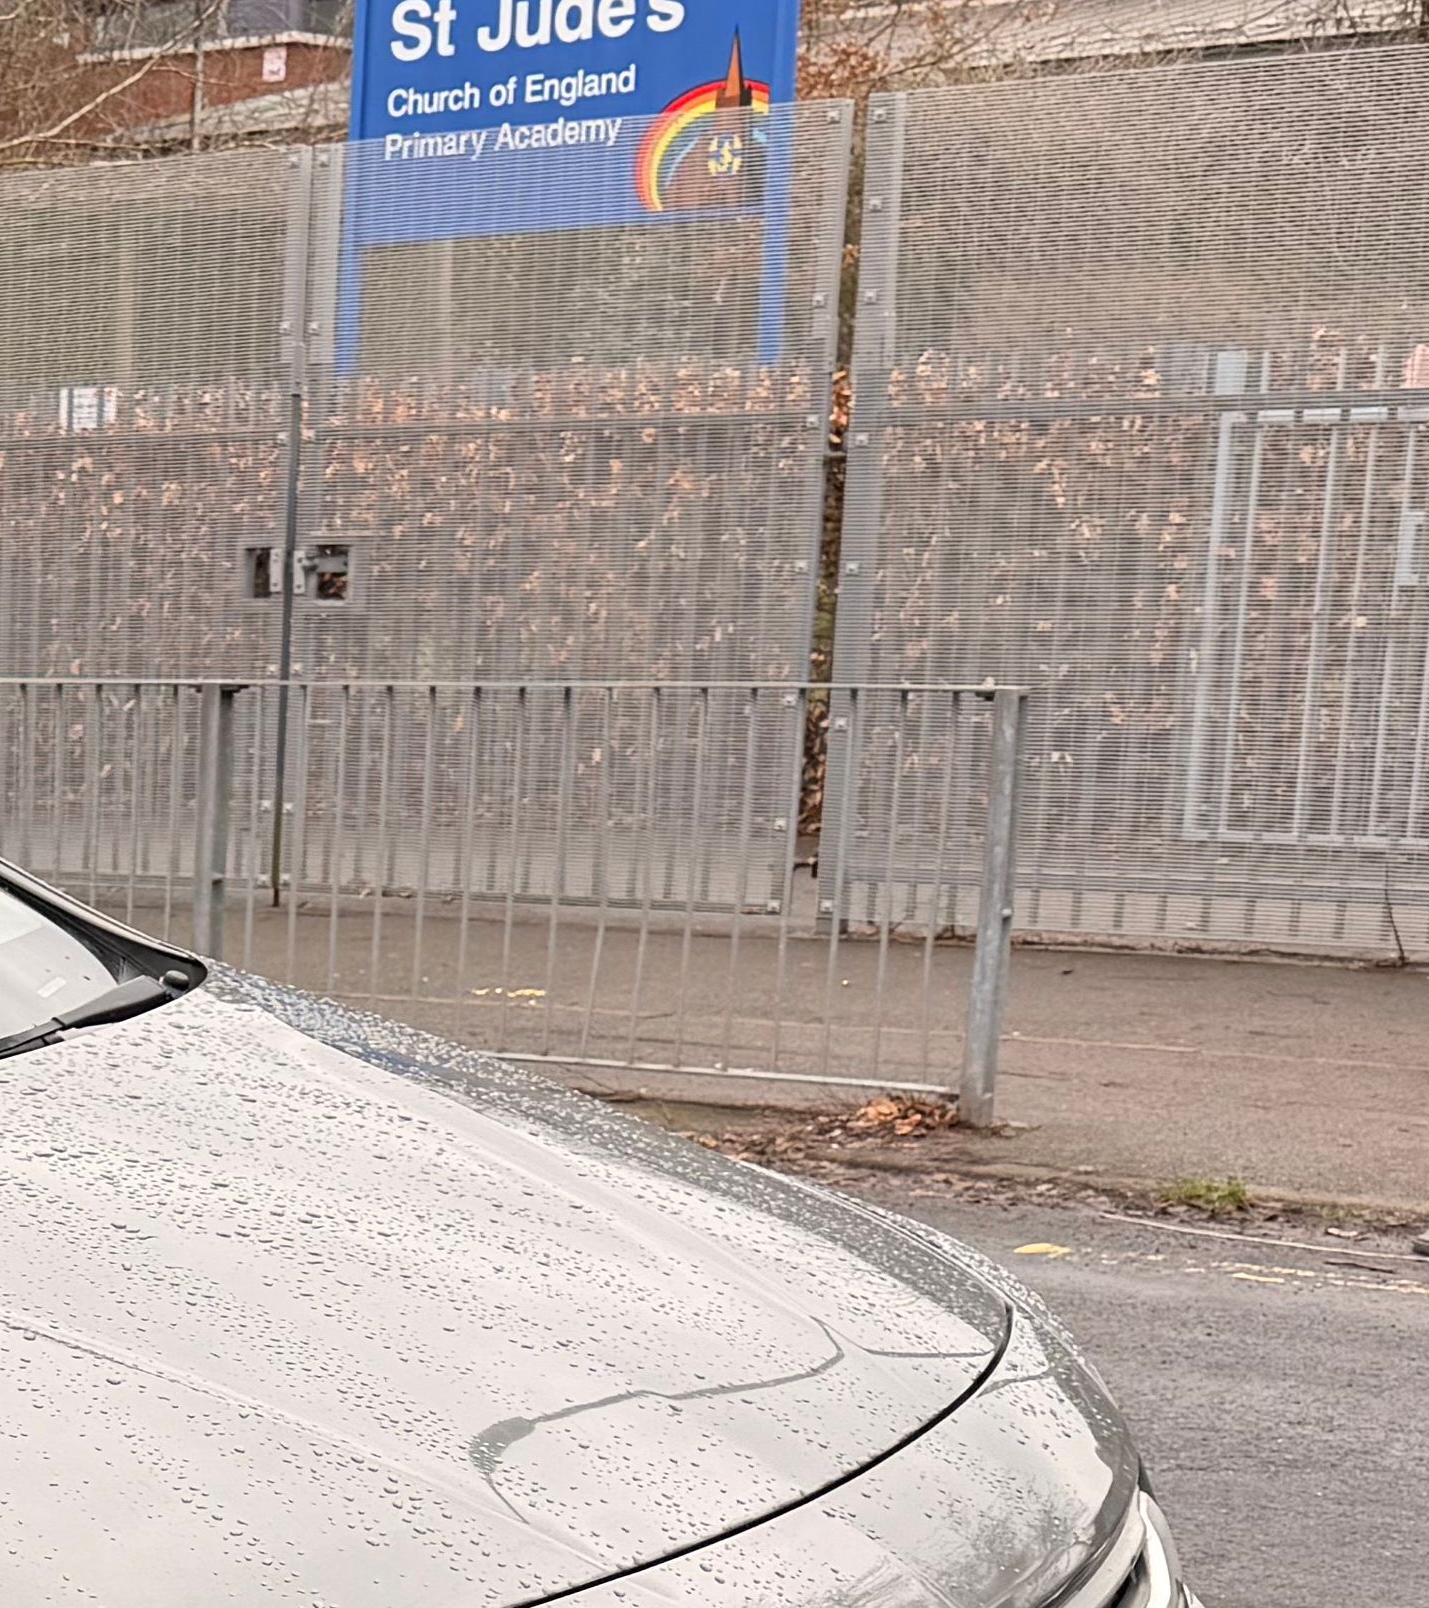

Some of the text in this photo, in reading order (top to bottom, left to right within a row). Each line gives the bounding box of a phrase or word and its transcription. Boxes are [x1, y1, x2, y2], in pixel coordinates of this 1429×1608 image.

[390, 0, 686, 62] St Judes
[387, 63, 637, 118] Church of England
[384, 117, 623, 161] Primary Academy
